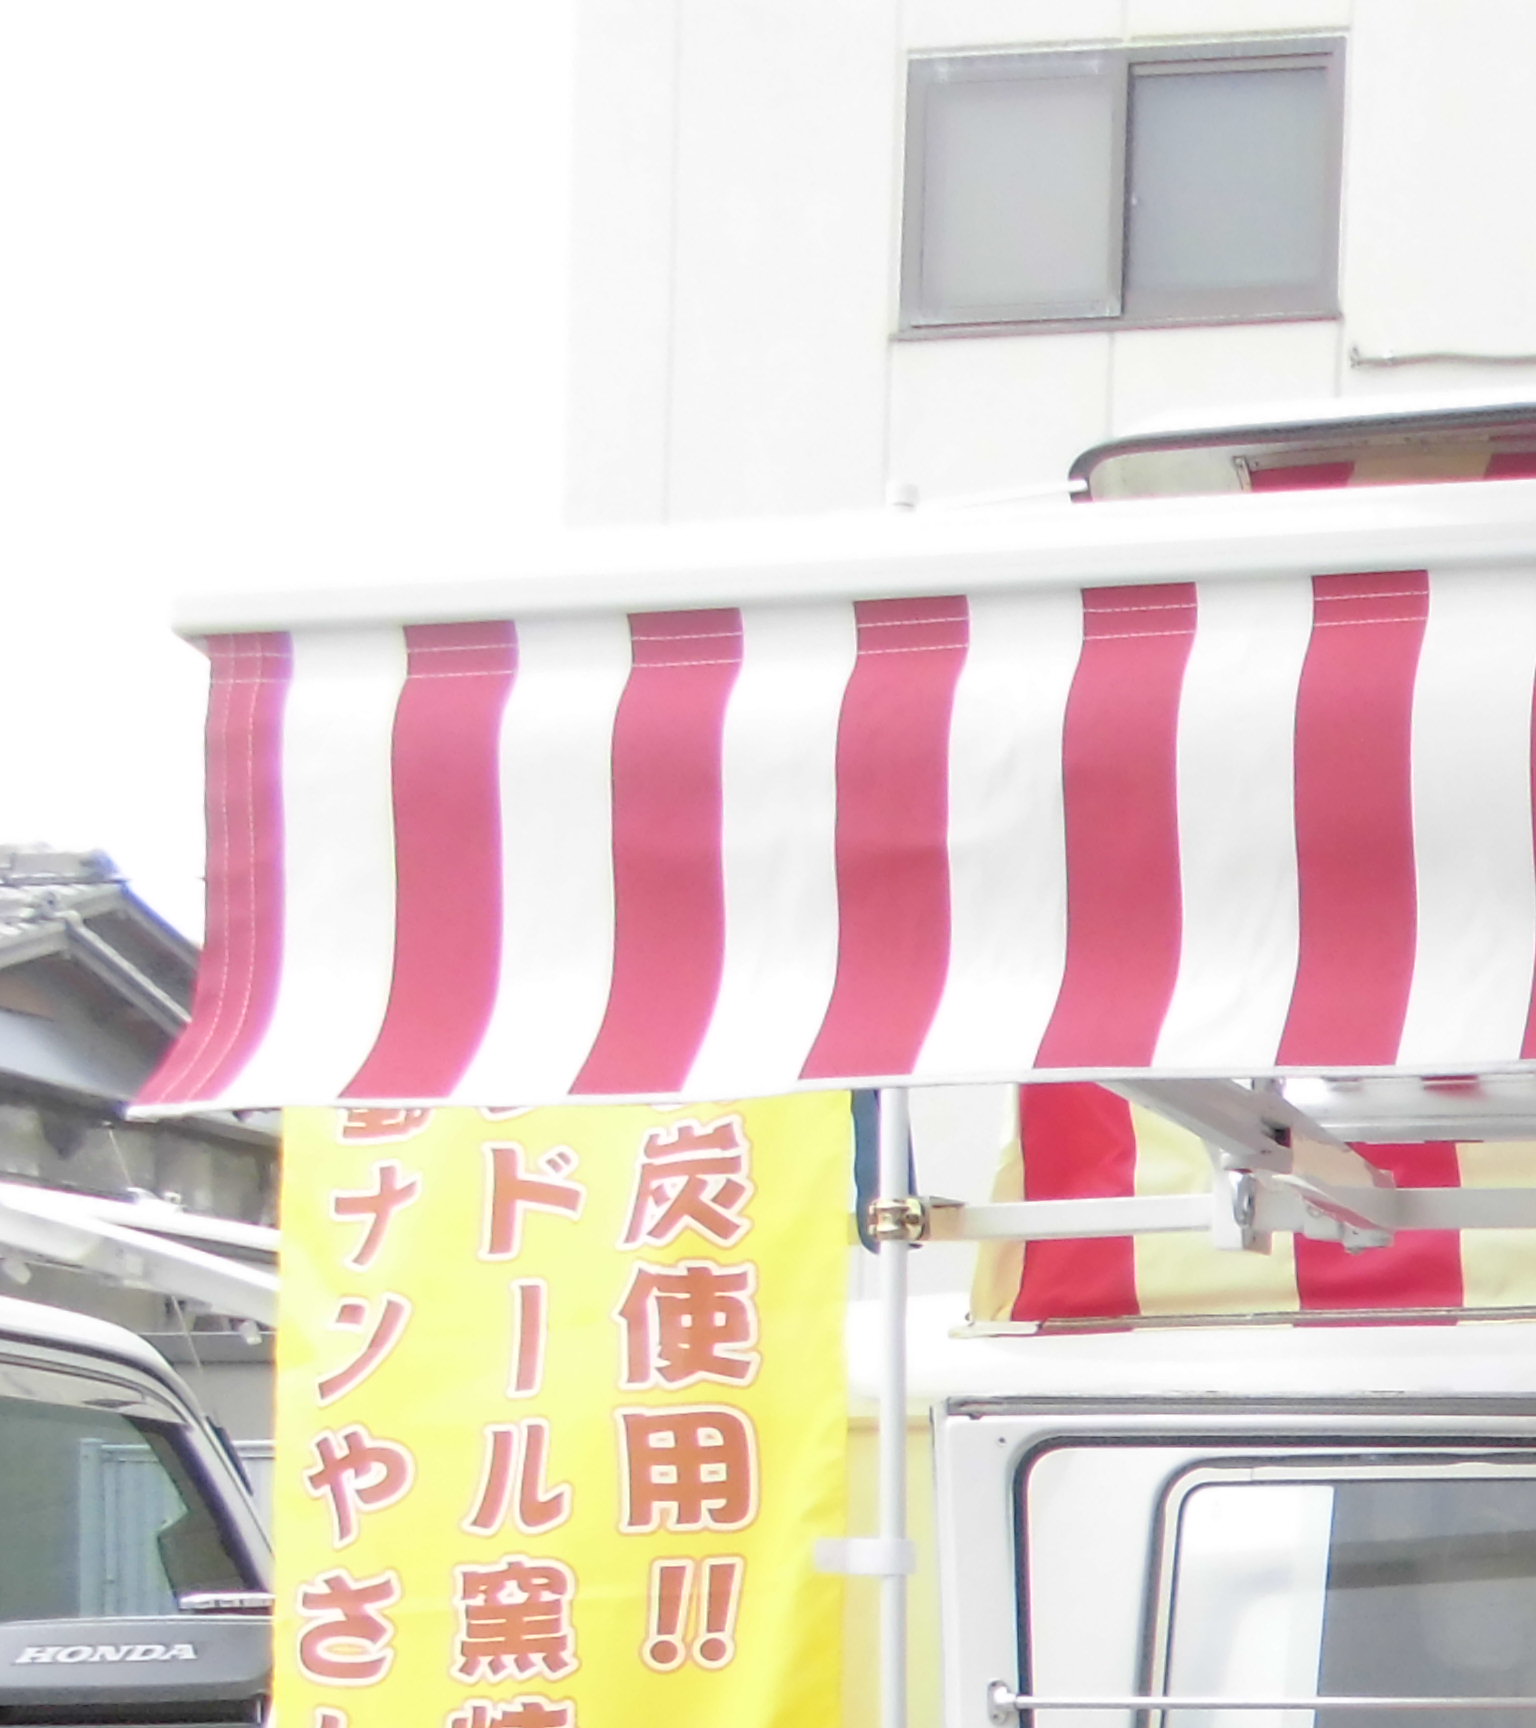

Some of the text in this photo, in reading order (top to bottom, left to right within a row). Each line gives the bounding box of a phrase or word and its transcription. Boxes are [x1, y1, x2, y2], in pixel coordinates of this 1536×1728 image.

[615, 1120, 759, 1669] 炭使用!!
[12, 1643, 198, 1665] HONDA
